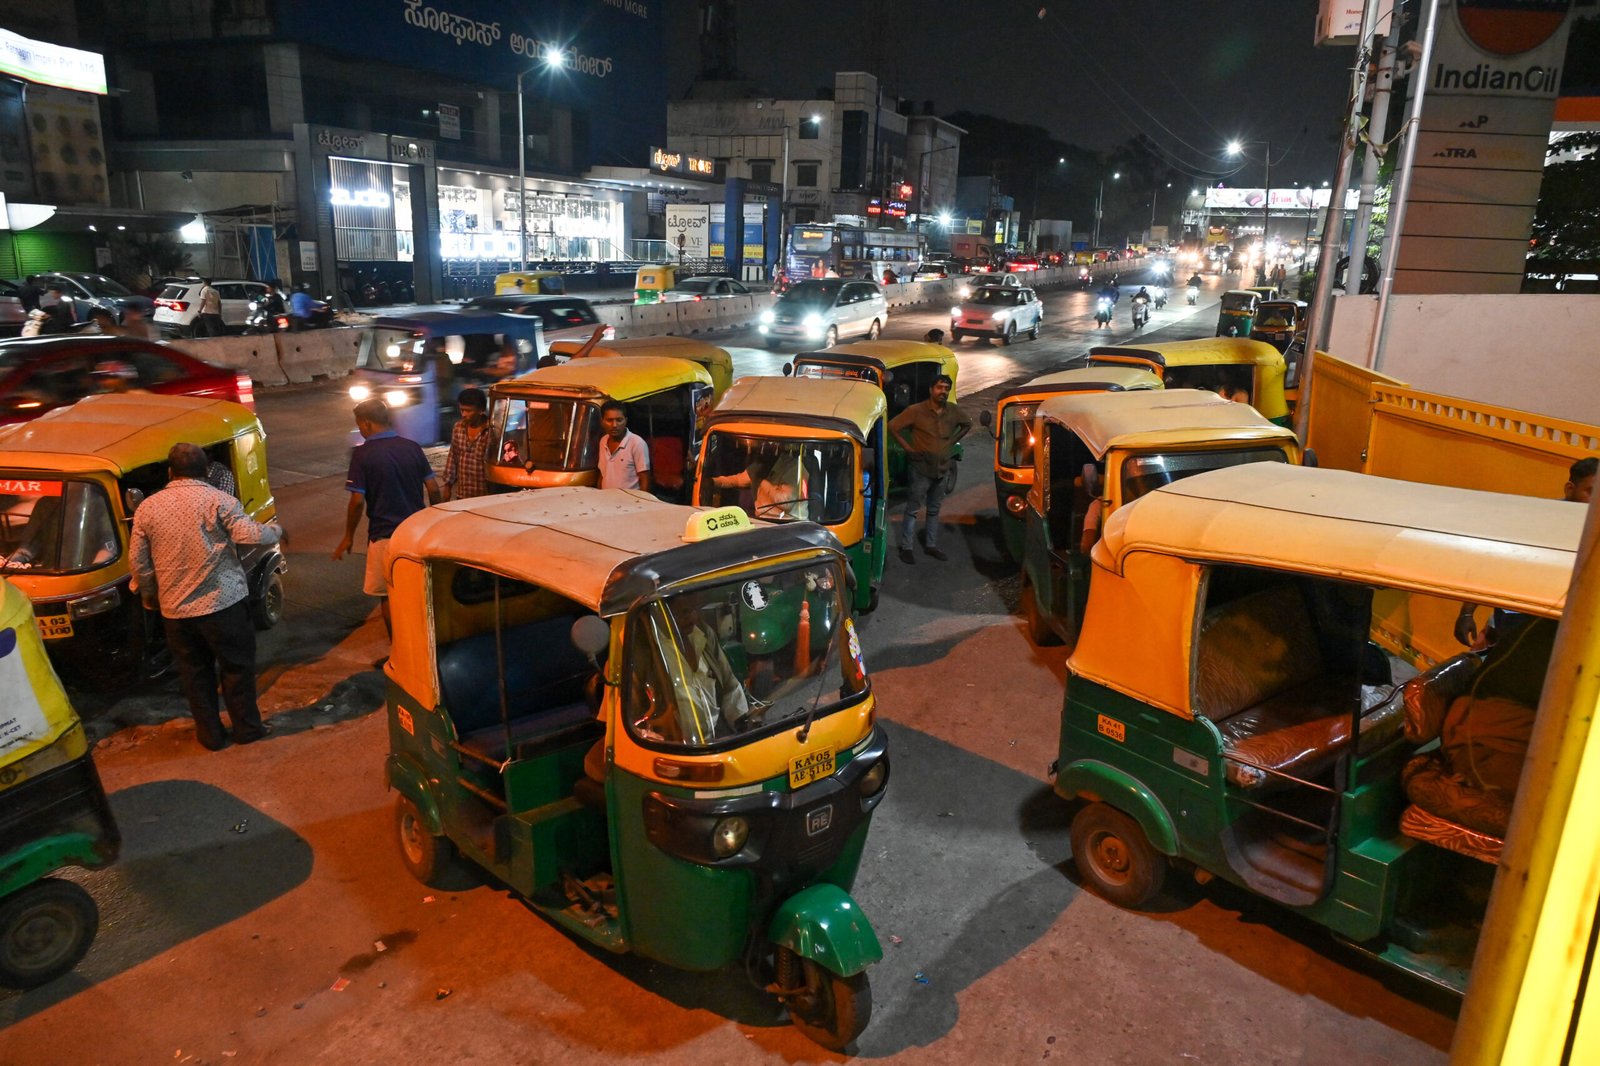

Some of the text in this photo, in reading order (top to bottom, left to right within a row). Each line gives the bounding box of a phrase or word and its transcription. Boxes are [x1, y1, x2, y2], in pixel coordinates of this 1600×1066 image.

[625, 0, 648, 19] MORE
[1435, 64, 1558, 93] IndianOil
[667, 214, 707, 233] ಟ್ರೋವ್
[1098, 724, 1104, 732] B
[1102, 717, 1112, 727] KA
[795, 750, 831, 770] KA 05
[811, 814, 828, 831] RE
